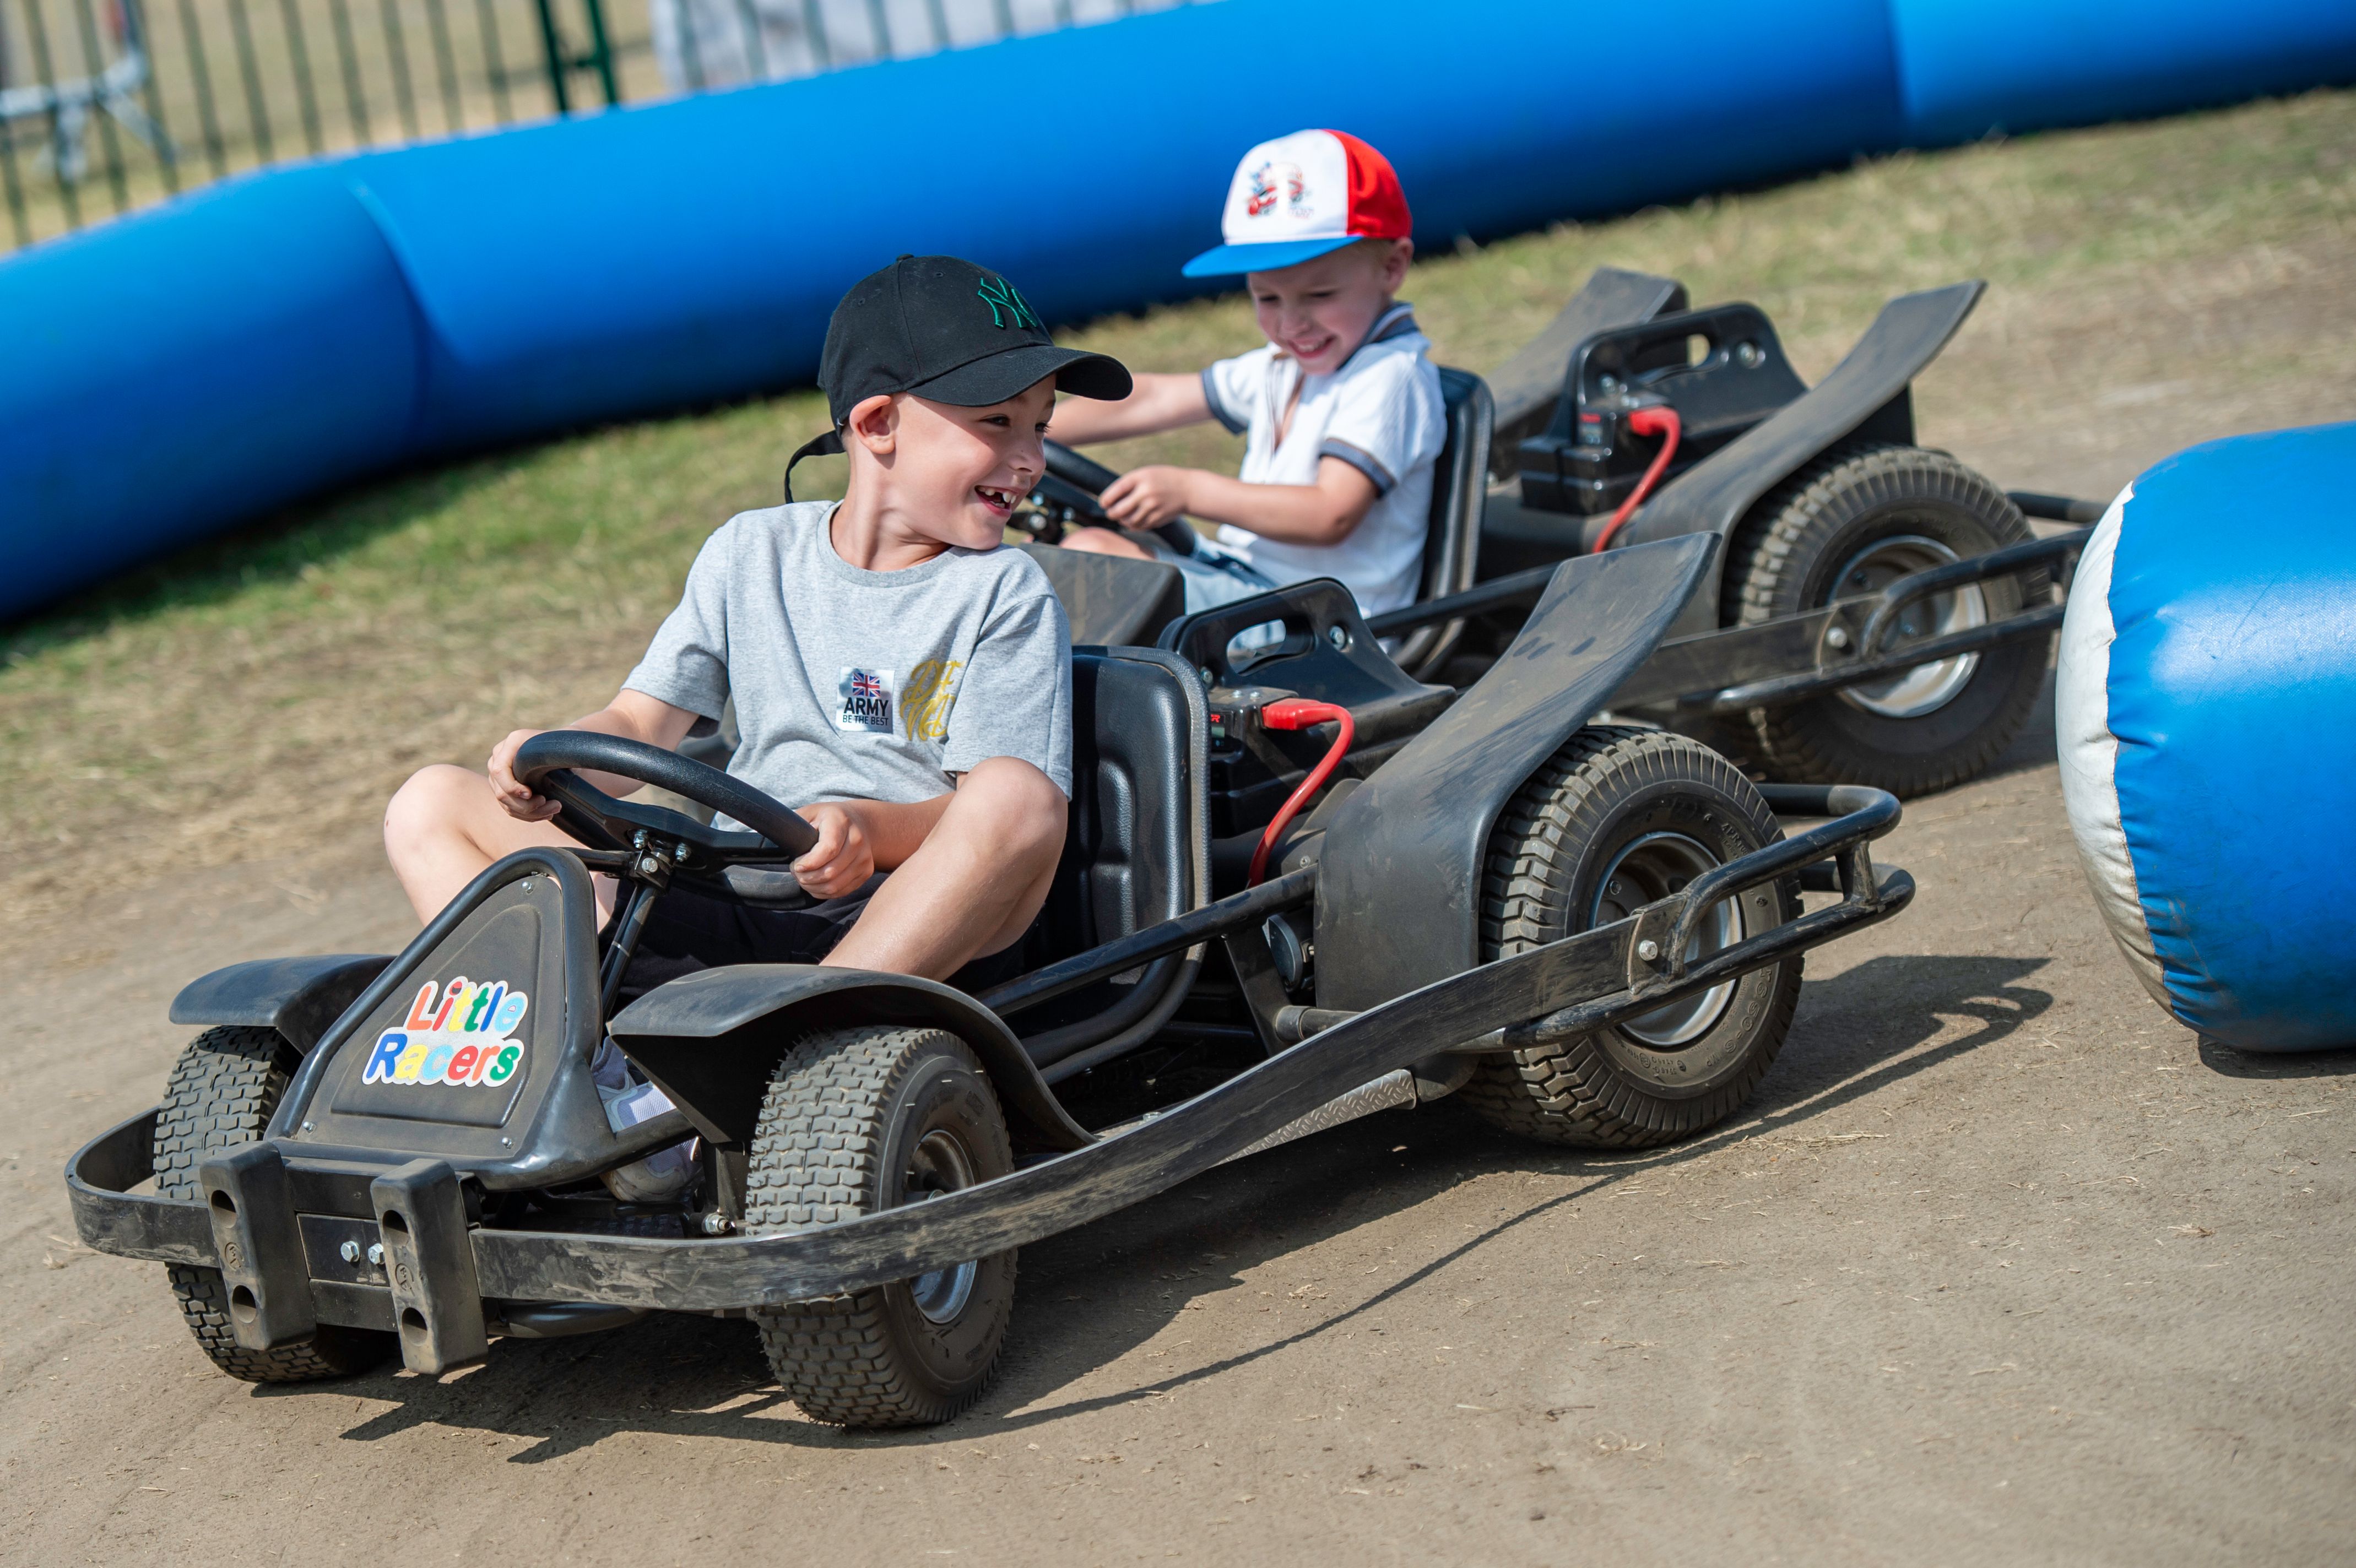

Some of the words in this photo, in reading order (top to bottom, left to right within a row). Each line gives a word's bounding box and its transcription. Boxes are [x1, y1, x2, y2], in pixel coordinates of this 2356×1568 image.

[977, 277, 1038, 329] NY
[843, 697, 889, 717] ARMY
[843, 715, 853, 723] BE
[854, 715, 869, 725] THE
[871, 716, 889, 726] BEST
[405, 981, 526, 1033] Little
[365, 1033, 520, 1082] Racers
